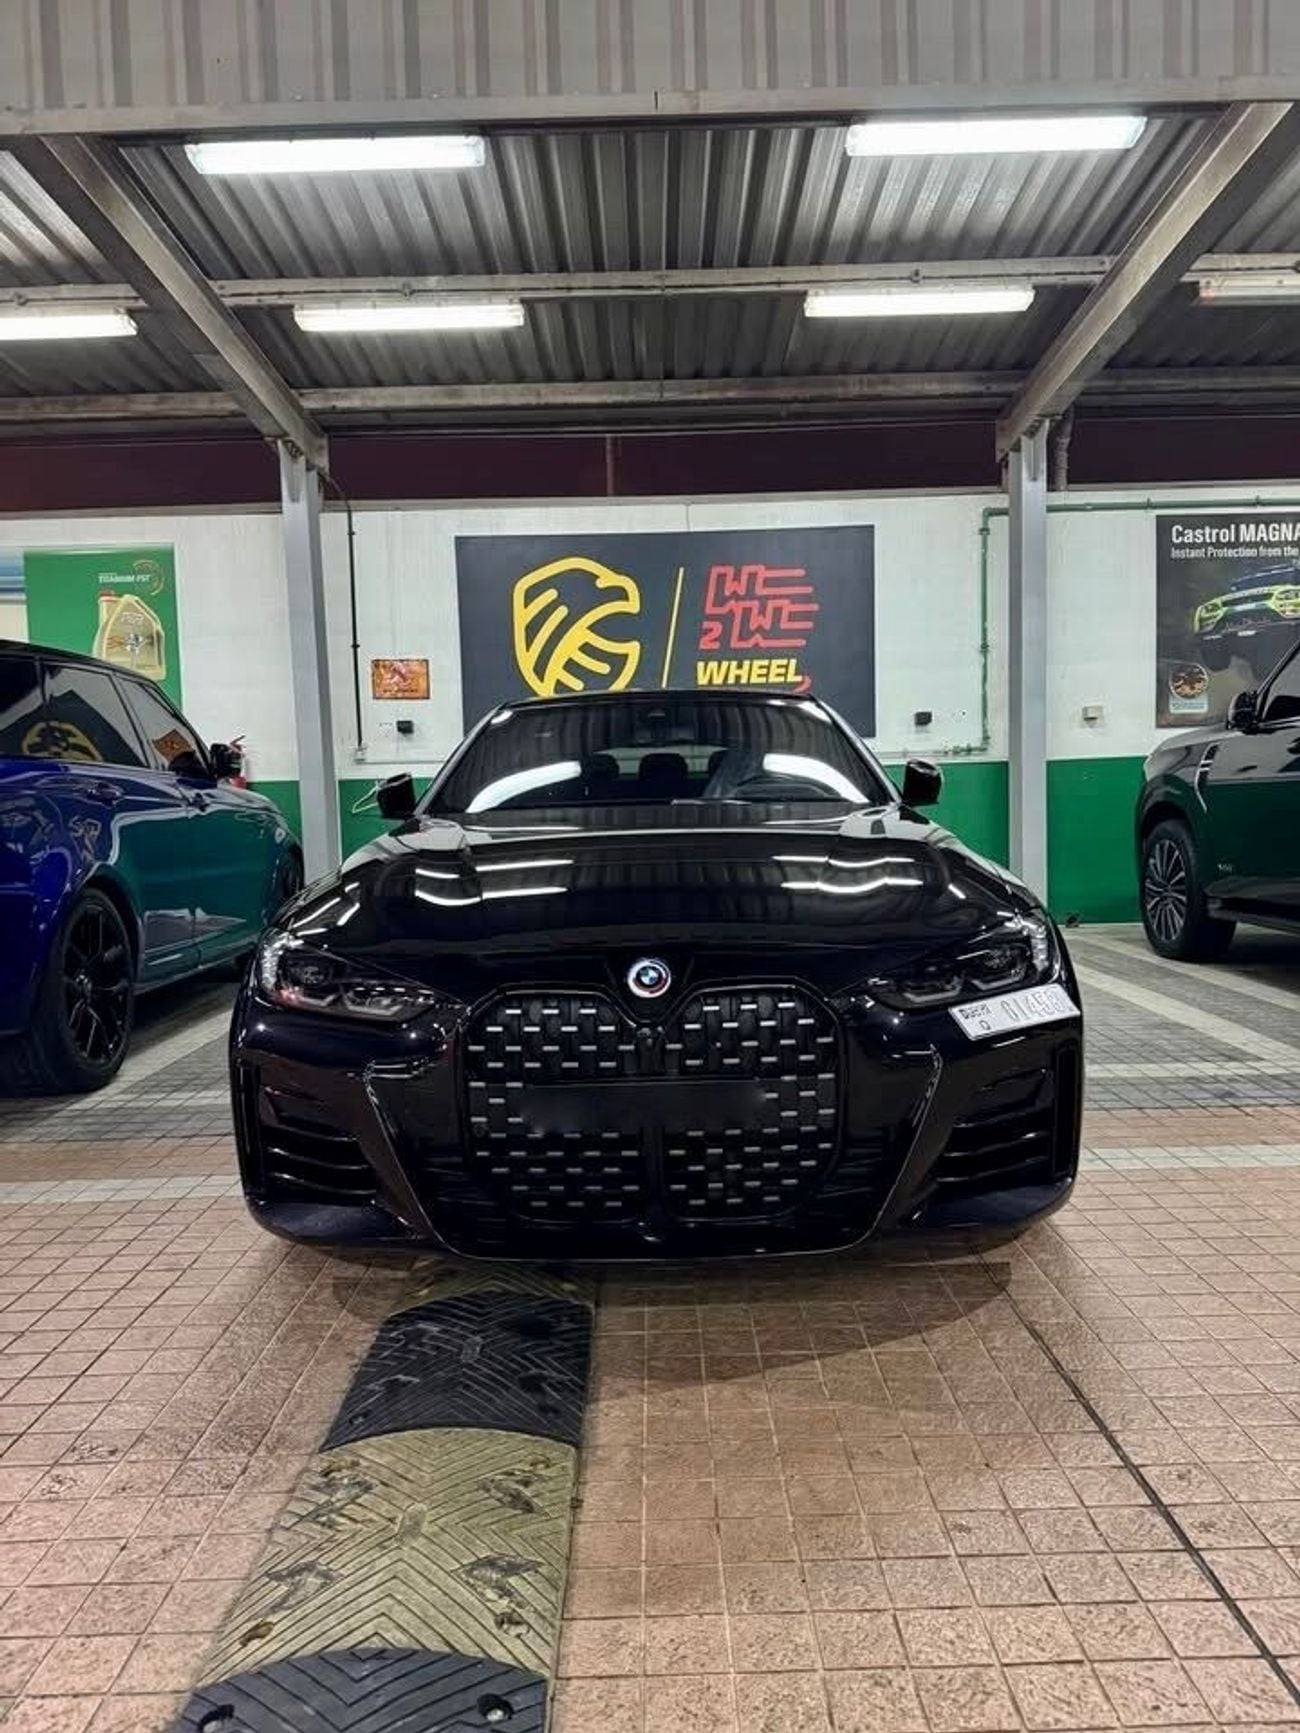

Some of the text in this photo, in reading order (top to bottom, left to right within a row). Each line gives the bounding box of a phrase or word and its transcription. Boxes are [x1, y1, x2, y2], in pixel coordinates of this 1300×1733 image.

[1171, 523, 1236, 543] Castrol
[1171, 545, 1300, 559] Instant Protection from the
[697, 659, 802, 686] WHEEL
